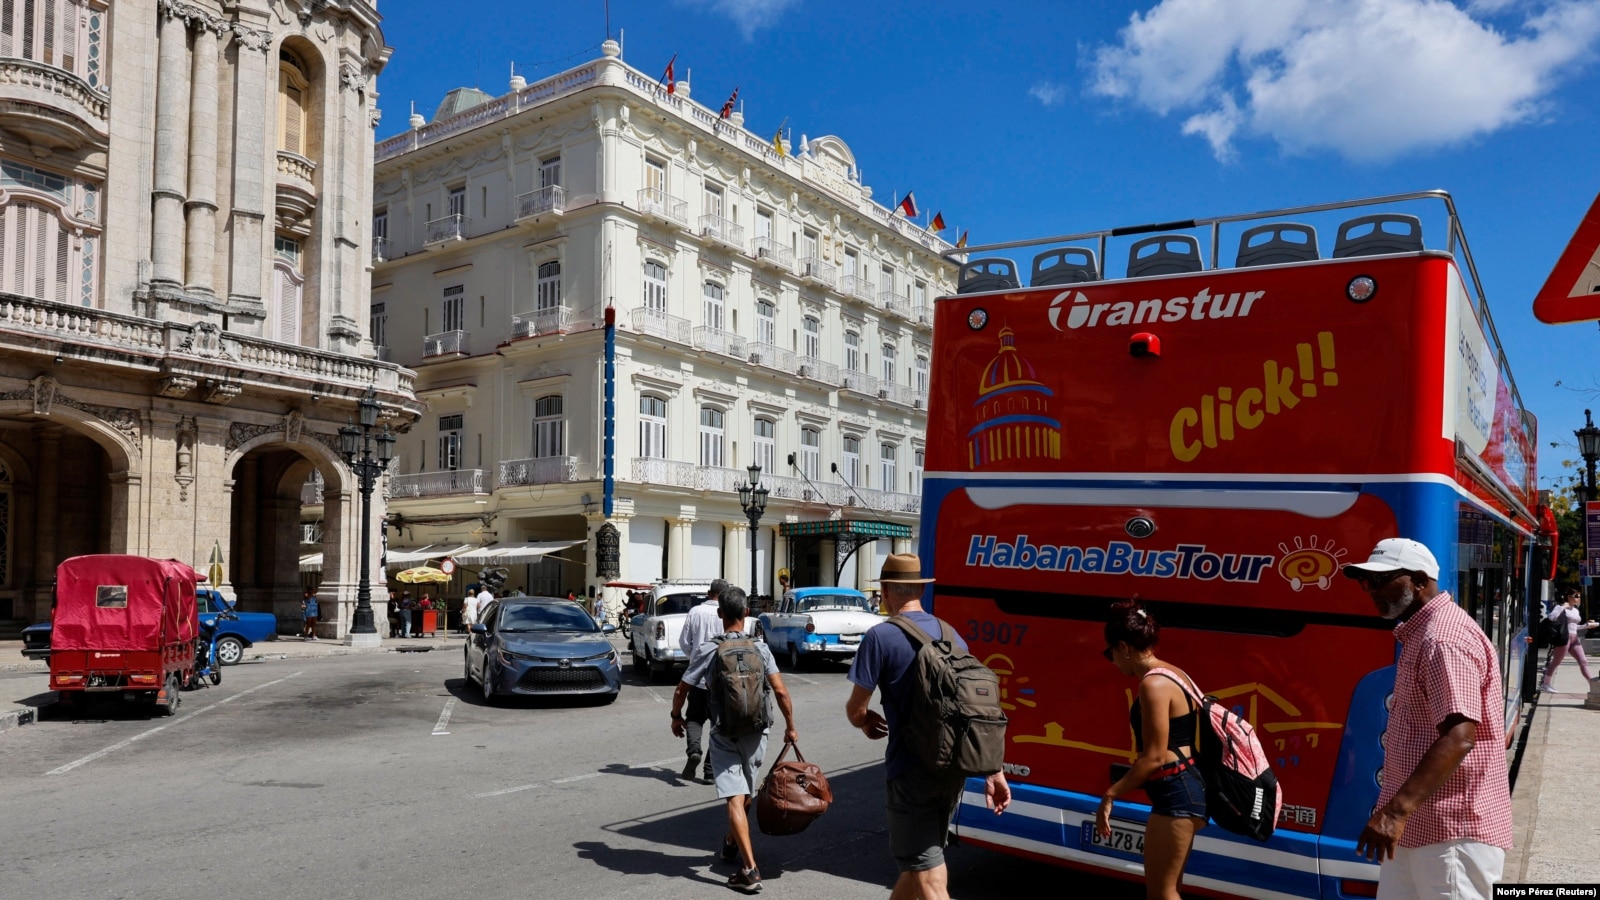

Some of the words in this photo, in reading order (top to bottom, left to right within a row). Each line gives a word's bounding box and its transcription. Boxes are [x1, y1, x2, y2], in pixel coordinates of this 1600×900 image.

[600, 537, 618, 545] GRAN
[966, 535, 1275, 583] HabanaBusTour
[966, 619, 1028, 647] 3907
[1250, 787, 1264, 820] PUMA
